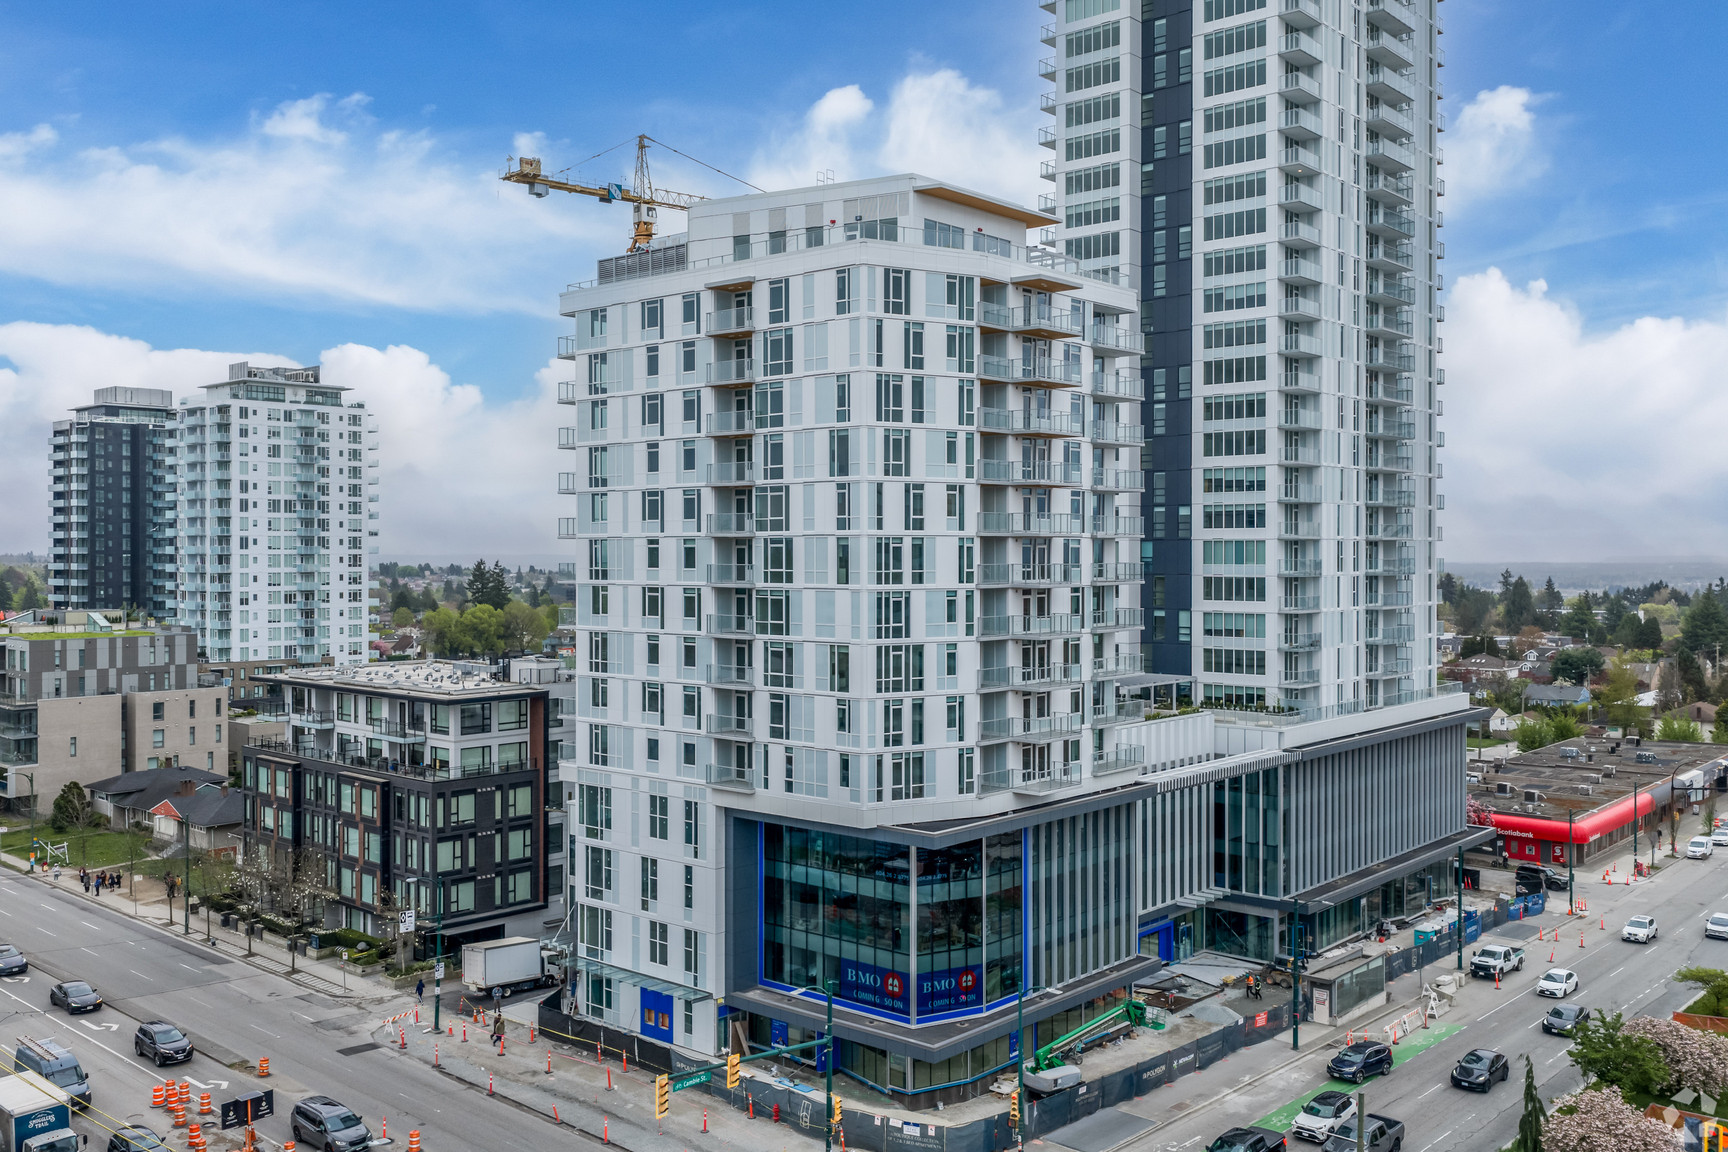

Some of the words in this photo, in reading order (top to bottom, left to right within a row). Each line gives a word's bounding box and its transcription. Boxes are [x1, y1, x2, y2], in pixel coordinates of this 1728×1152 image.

[1497, 828, 1533, 838] Scotiabank
[847, 968, 881, 988] BMO
[922, 978, 956, 994] BMO
[853, 989, 880, 1004] COMING
[884, 997, 904, 1009] SOON
[928, 996, 955, 1009] COMING
[958, 993, 976, 1004] SOON
[1146, 1064, 1166, 1079] POLYGON
[683, 1077, 701, 1088] Cambie
[700, 1075, 708, 1083] St.
